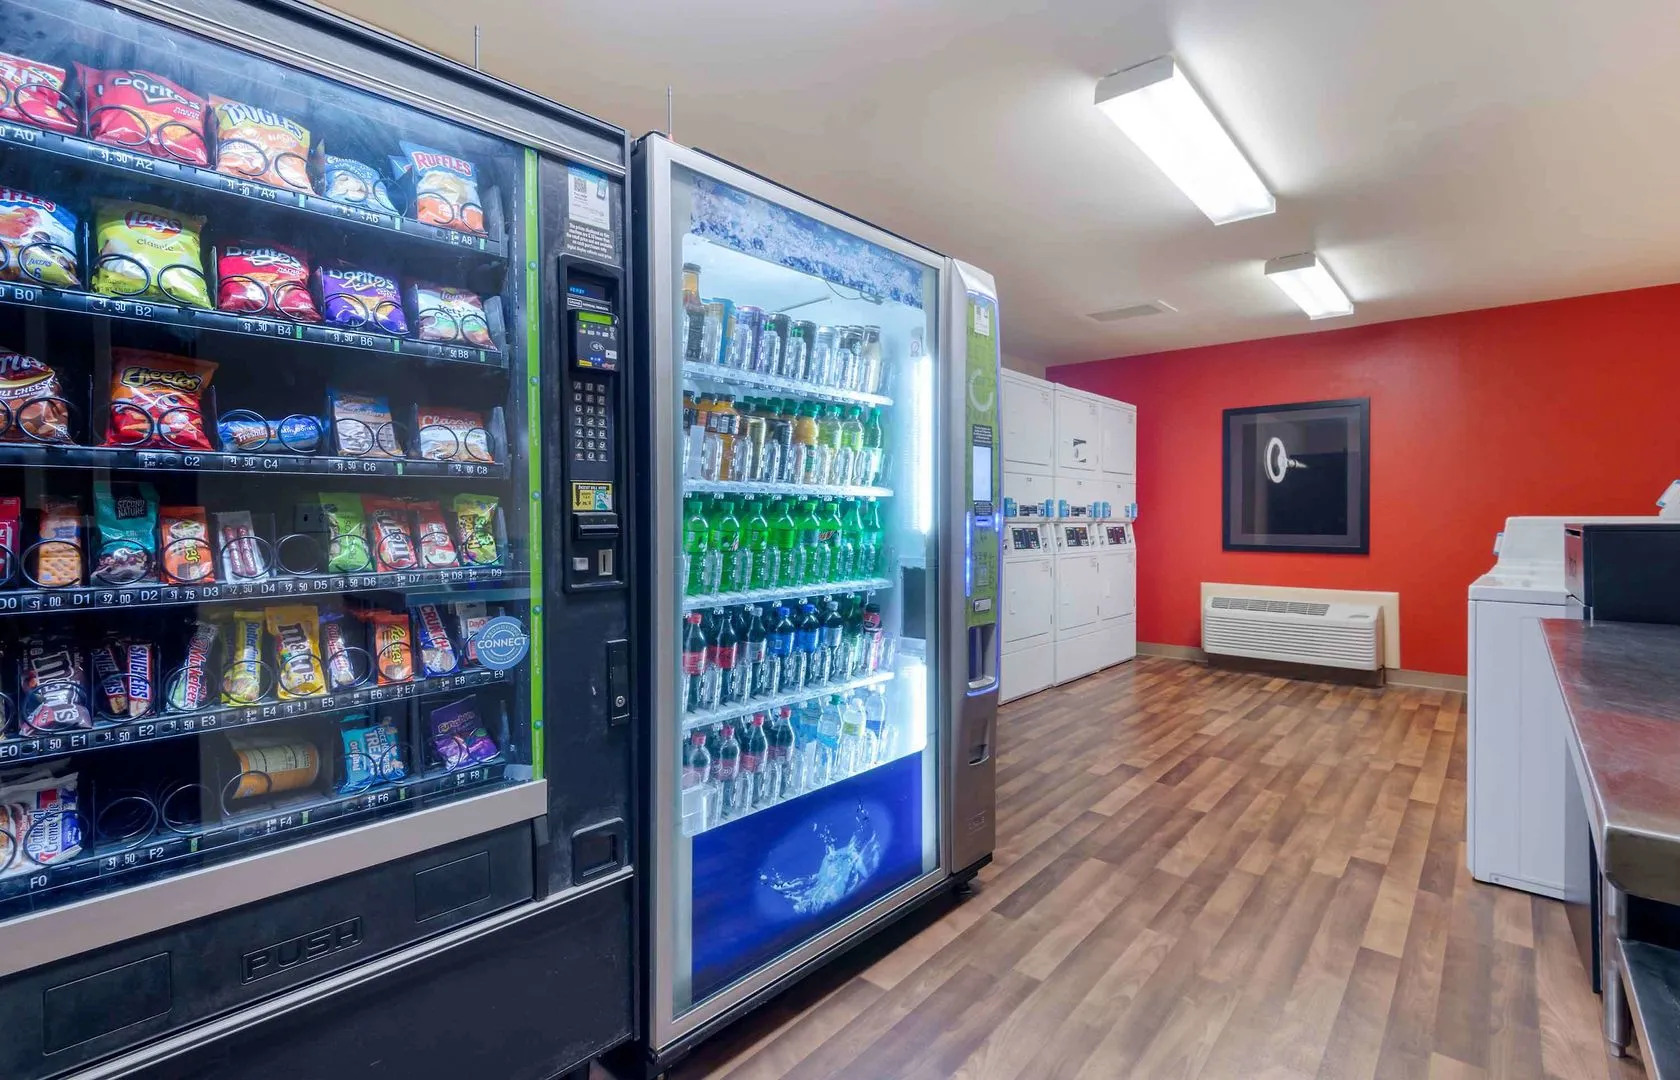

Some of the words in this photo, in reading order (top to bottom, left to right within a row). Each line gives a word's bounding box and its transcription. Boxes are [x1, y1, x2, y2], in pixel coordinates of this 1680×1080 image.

[114, 77, 200, 110] Doritos
[136, 158, 153, 170] A2
[411, 151, 472, 176] RUFFLES
[261, 187, 276, 199] A4
[461, 235, 473, 246] A8
[226, 246, 302, 269] Doritos
[329, 269, 395, 290] Doritos
[14, 288, 34, 302] B0
[135, 305, 152, 318] B2
[277, 325, 291, 336] B4
[360, 336, 373, 347] B6
[458, 349, 469, 359] B8
[121, 367, 201, 392] Cheetos
[184, 455, 200, 467] C2
[264, 458, 278, 469] C4
[363, 462, 376, 471] C6
[477, 465, 488, 475] C8
[117, 499, 145, 509] SECOND
[118, 506, 145, 518] NATURE
[409, 572, 421, 583] D7
[451, 569, 463, 580] D8
[491, 568, 502, 577] D9
[314, 580, 327, 590] D5
[363, 577, 377, 587] D6
[203, 586, 219, 598] D3
[261, 584, 275, 594] D4
[74, 593, 90, 605] D1
[141, 590, 158, 601] D2
[477, 636, 528, 649] CONNECT
[129, 645, 149, 699] SNICKERS
[494, 669, 504, 679] E9
[455, 676, 465, 686] E8
[370, 690, 382, 699] E6
[405, 685, 415, 694] E7
[322, 698, 334, 708] E5
[263, 707, 276, 718] E4
[201, 716, 216, 727] E3
[139, 725, 155, 737] E2
[71, 735, 86, 747] E1
[0, 745, 17, 757] E0
[470, 770, 480, 780] F8
[377, 793, 389, 804] F6
[280, 816, 292, 827] F4
[150, 847, 164, 860] F2
[30, 875, 47, 889] F0
[244, 919, 361, 981] PUSH
